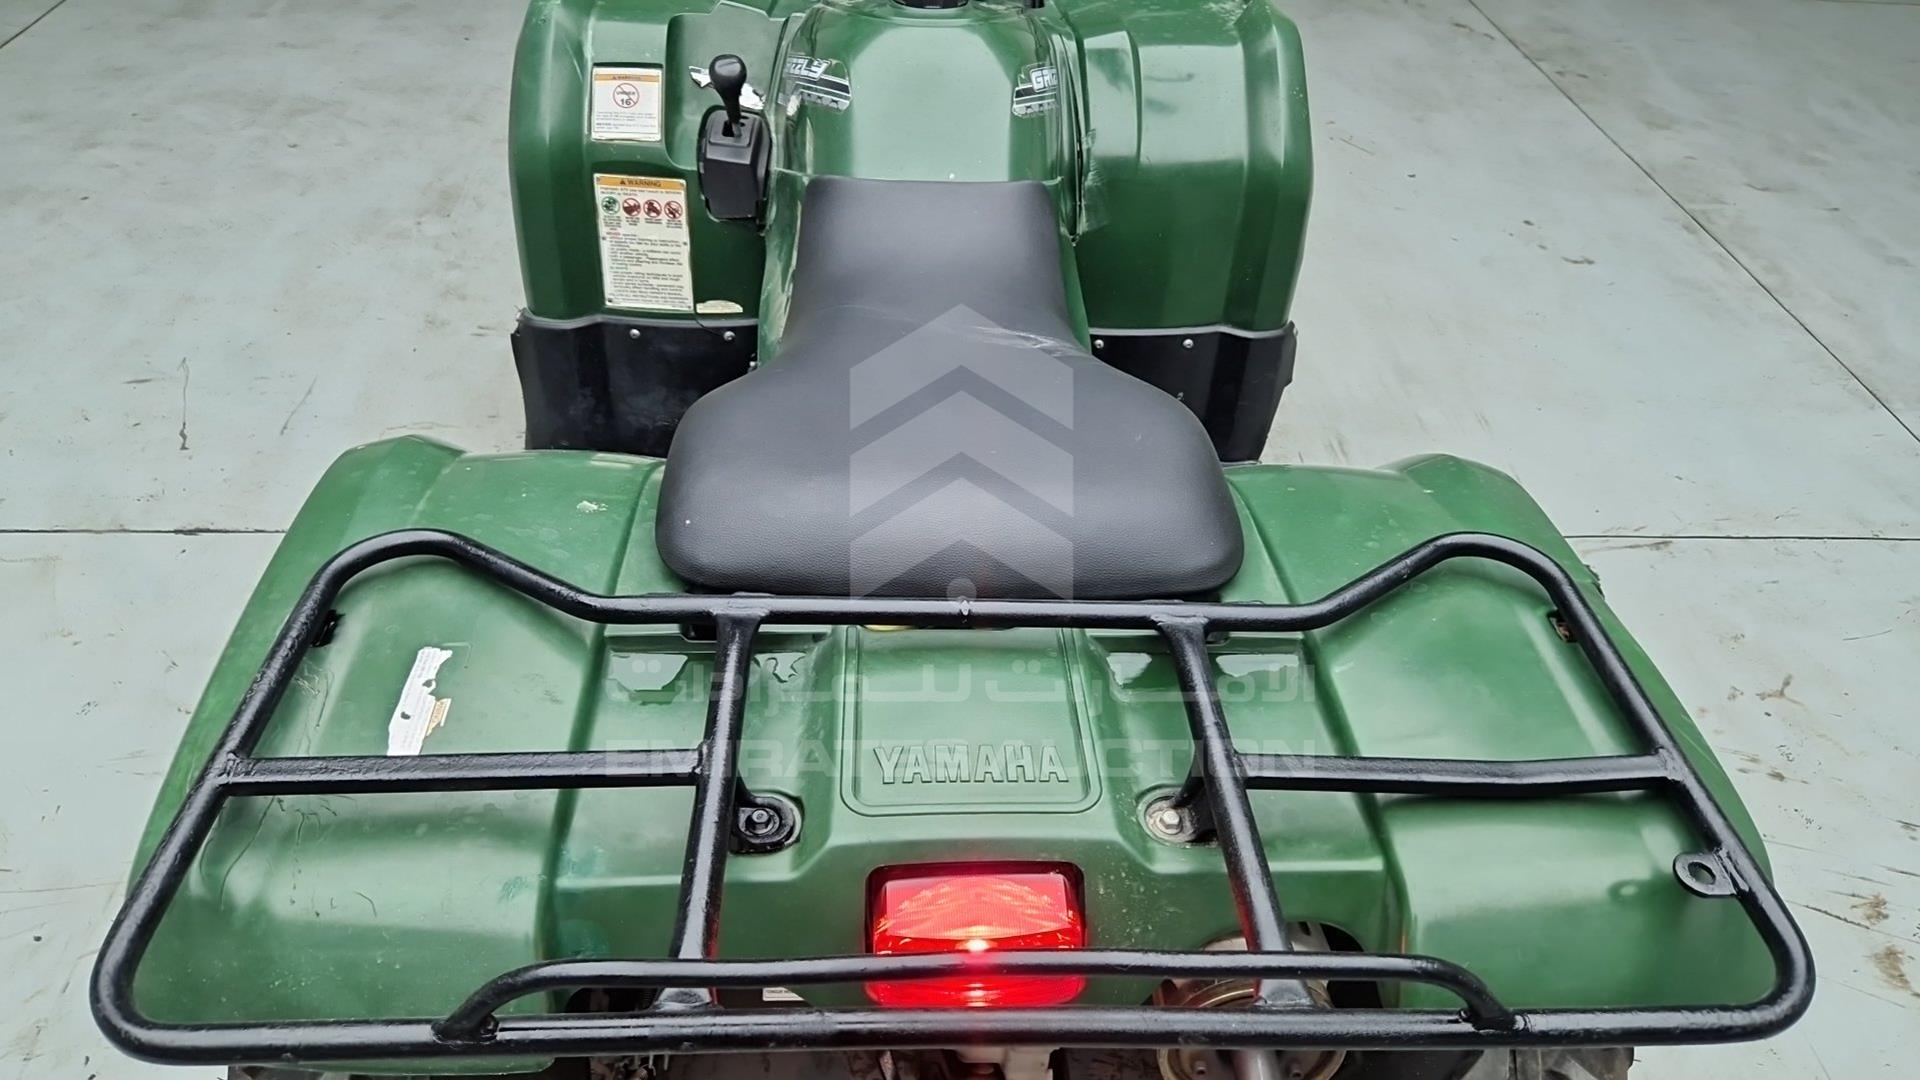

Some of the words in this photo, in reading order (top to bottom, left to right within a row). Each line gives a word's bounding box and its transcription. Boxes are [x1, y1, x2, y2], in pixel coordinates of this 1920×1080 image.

[620, 98, 632, 106] 16
[627, 179, 662, 188] WARNING
[873, 744, 1069, 784] YAMAHA
